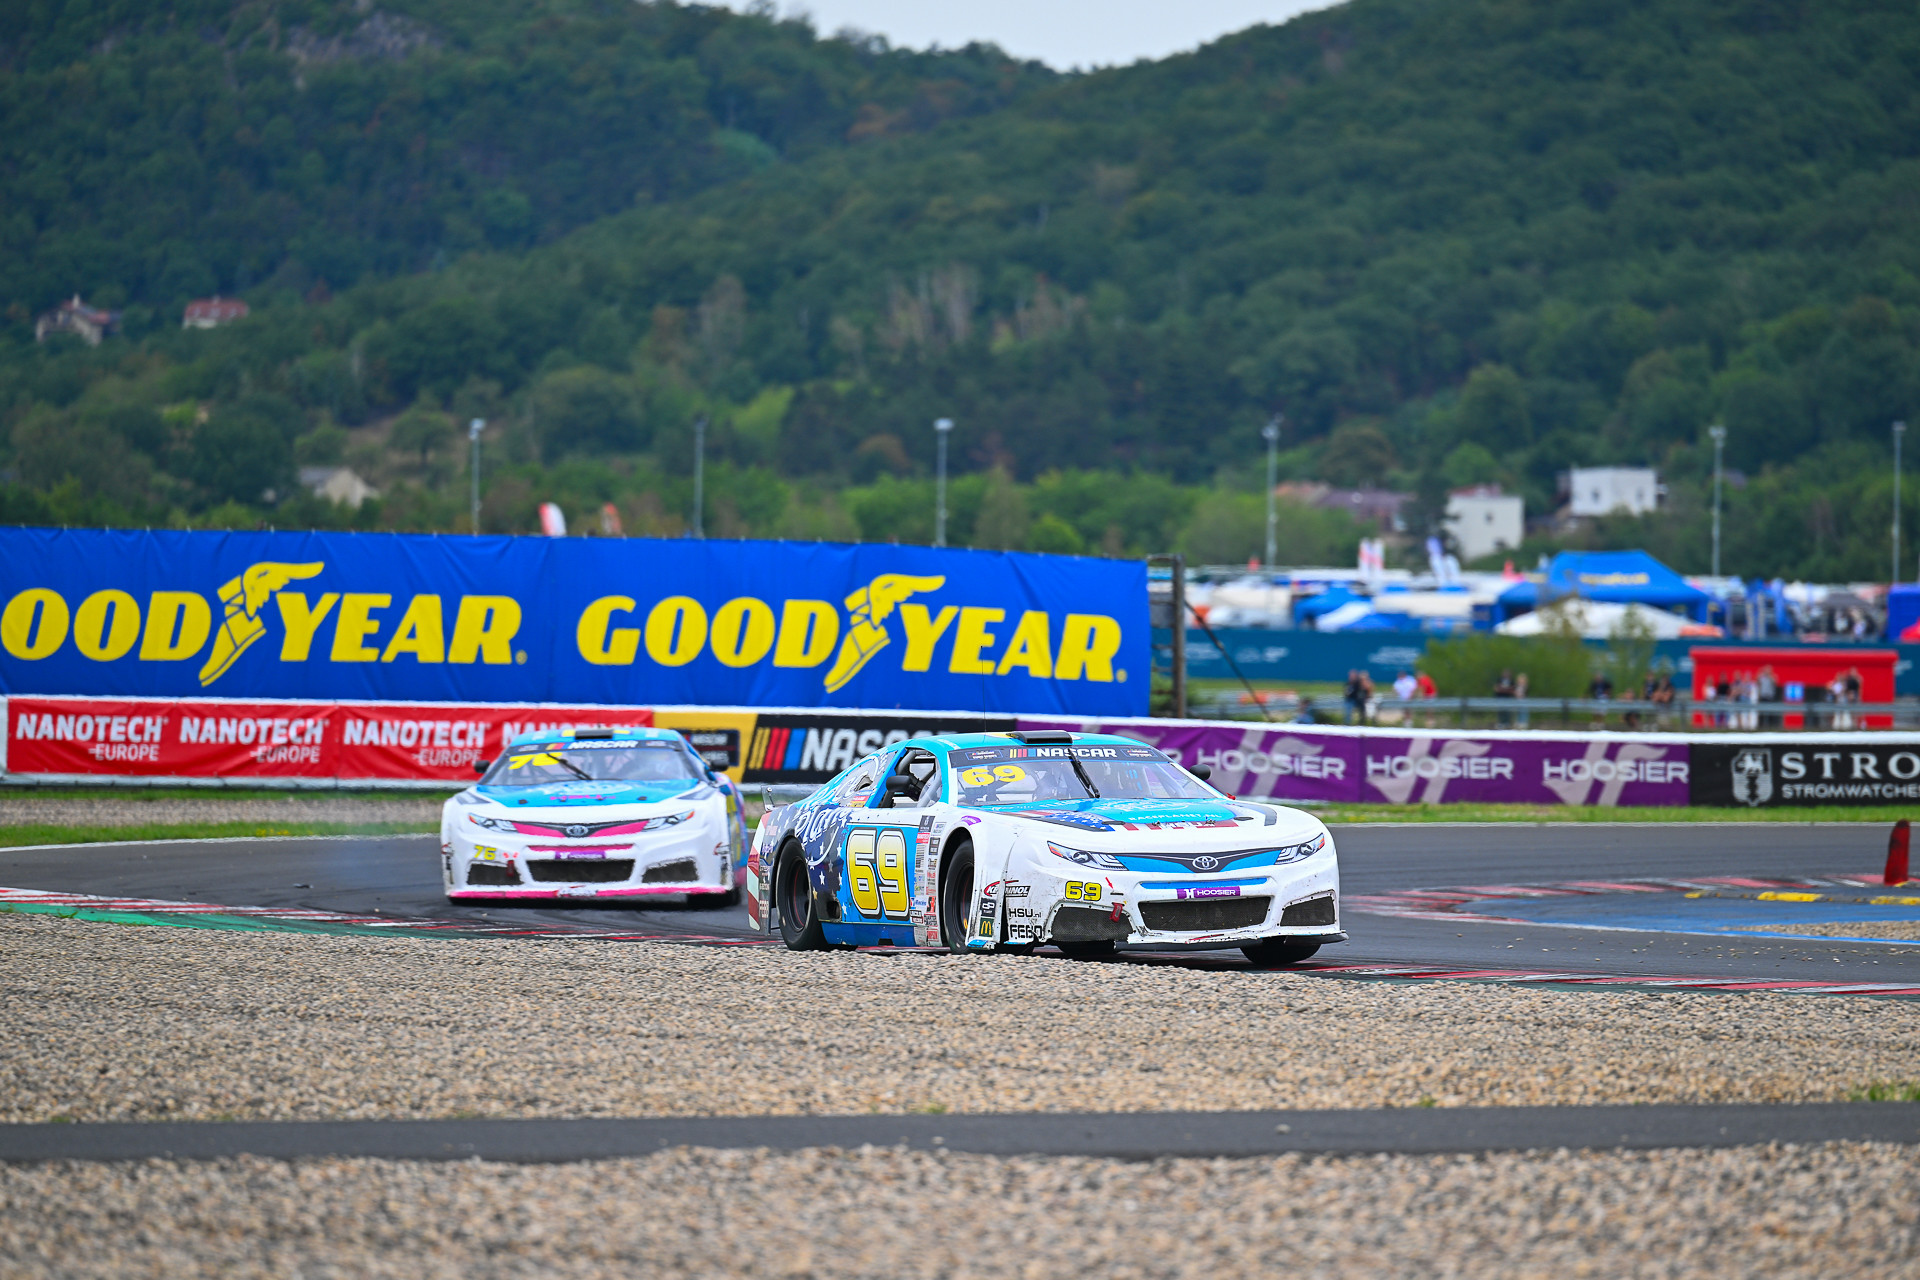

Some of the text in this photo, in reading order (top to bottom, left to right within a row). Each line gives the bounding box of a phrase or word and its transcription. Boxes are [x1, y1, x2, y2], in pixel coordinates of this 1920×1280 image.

[16, 713, 163, 742] NANOTECH
[179, 717, 324, 744] NANOTECH
[343, 719, 486, 747] NANOTECH
[94, 743, 160, 761] EUROPE
[255, 745, 321, 763] EUROPE
[568, 740, 638, 749] NASCAR
[1037, 748, 1117, 759] NASCAR
[418, 748, 482, 766] EUROPE
[508, 752, 563, 770] 76
[1197, 748, 1347, 780] HOOSIER
[1366, 755, 1514, 780] HOOSIER
[1780, 752, 1920, 779] STRO
[962, 765, 1026, 786] 69
[1542, 758, 1690, 783] HOOSIER
[1781, 783, 1920, 799] STROMWATCHE
[474, 845, 497, 861] 76
[846, 829, 911, 921] 69
[1064, 880, 1103, 902] 69
